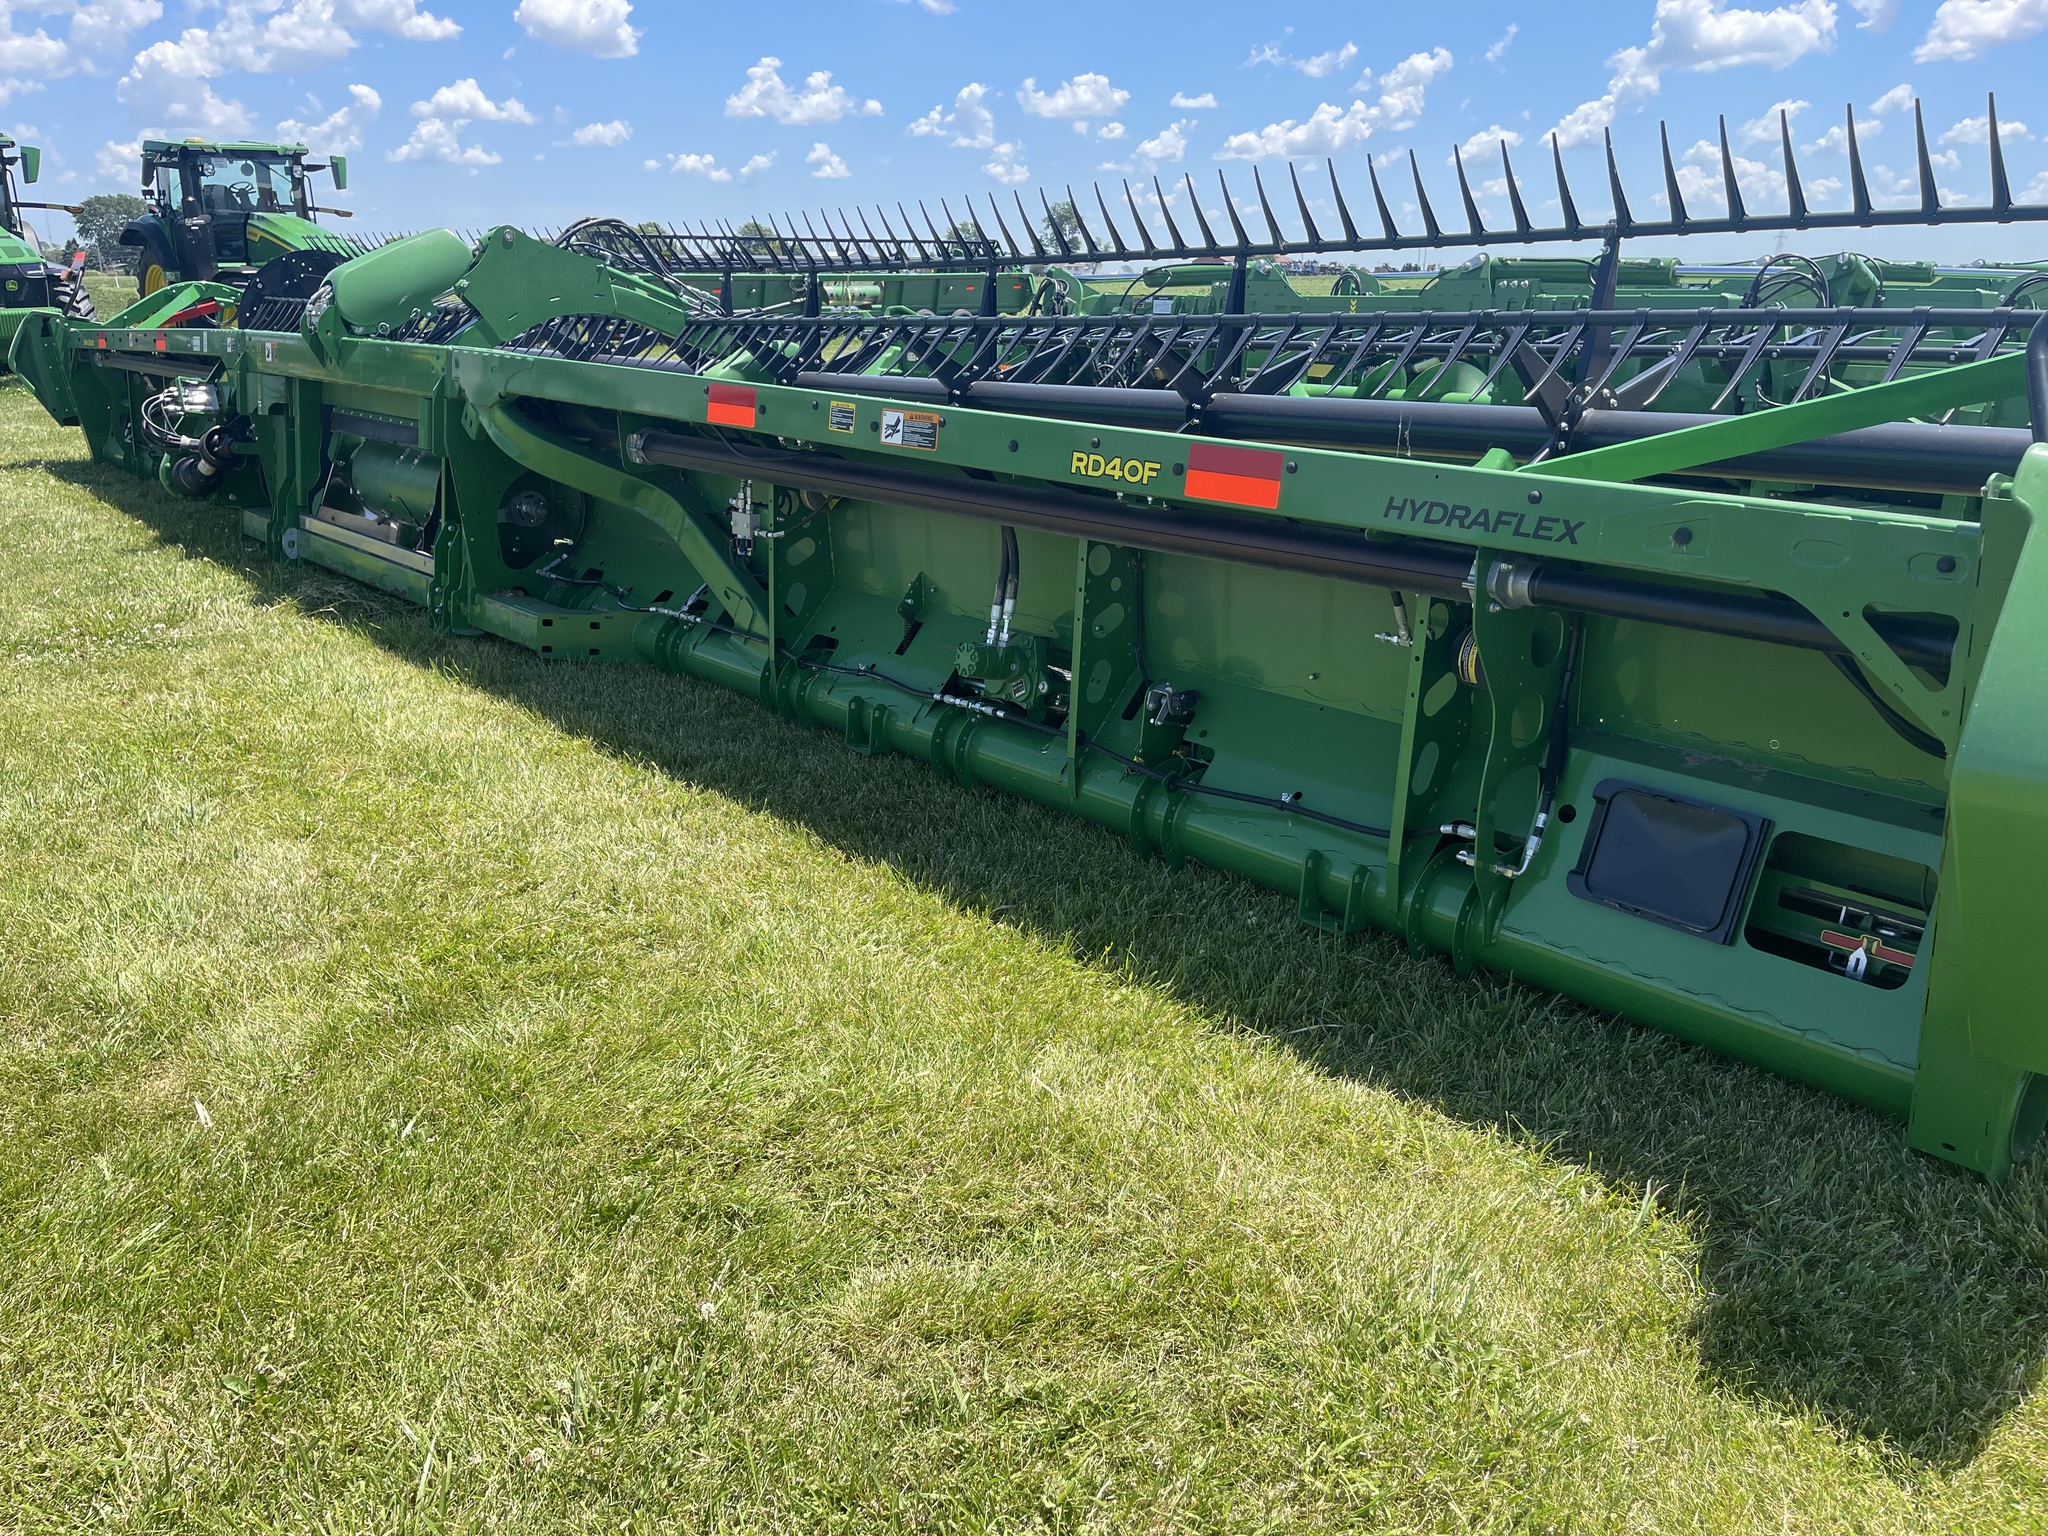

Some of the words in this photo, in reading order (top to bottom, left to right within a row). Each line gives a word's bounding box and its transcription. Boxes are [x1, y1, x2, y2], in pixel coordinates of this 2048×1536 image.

[914, 413, 934, 422] WARNING
[1070, 450, 1162, 485] RD40F
[1383, 496, 1586, 545] HYDRAFLEX
